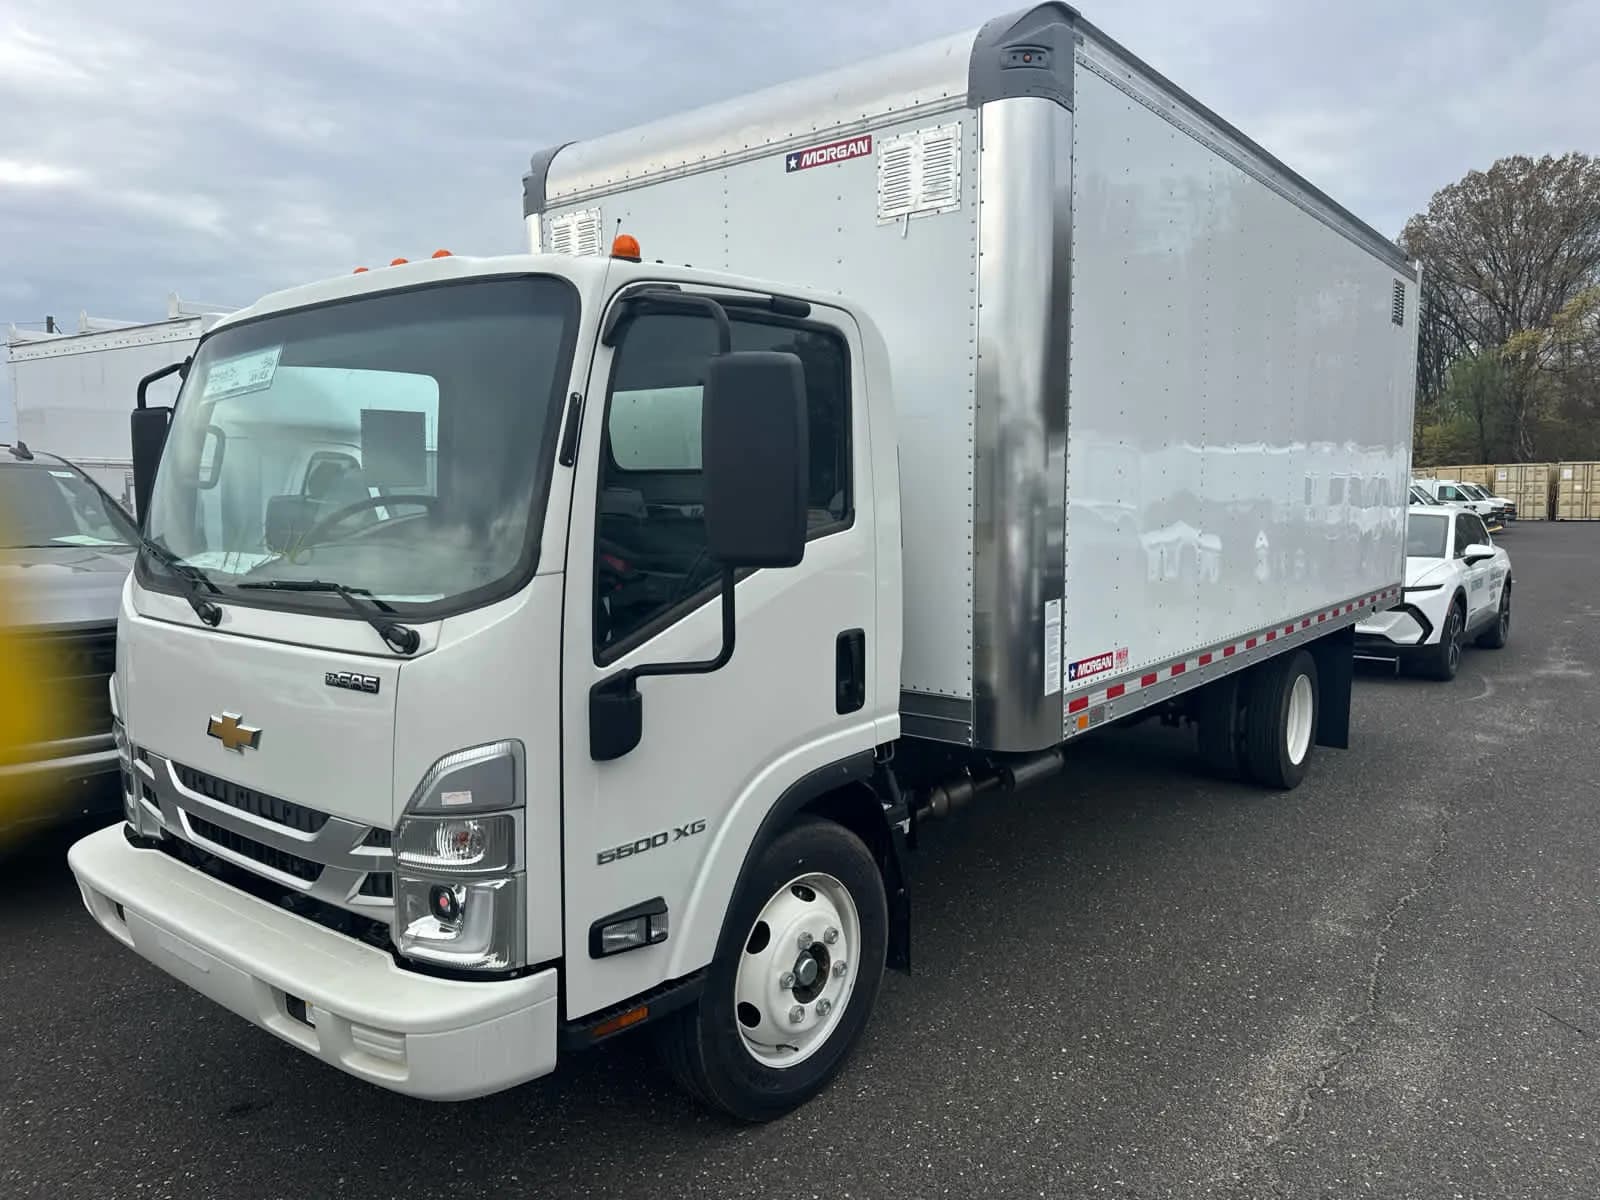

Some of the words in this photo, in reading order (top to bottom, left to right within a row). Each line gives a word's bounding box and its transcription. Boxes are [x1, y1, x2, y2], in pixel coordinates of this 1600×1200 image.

[801, 139, 869, 167] MORGAN
[1077, 655, 1112, 677] MORGAN
[673, 819, 706, 841] XG
